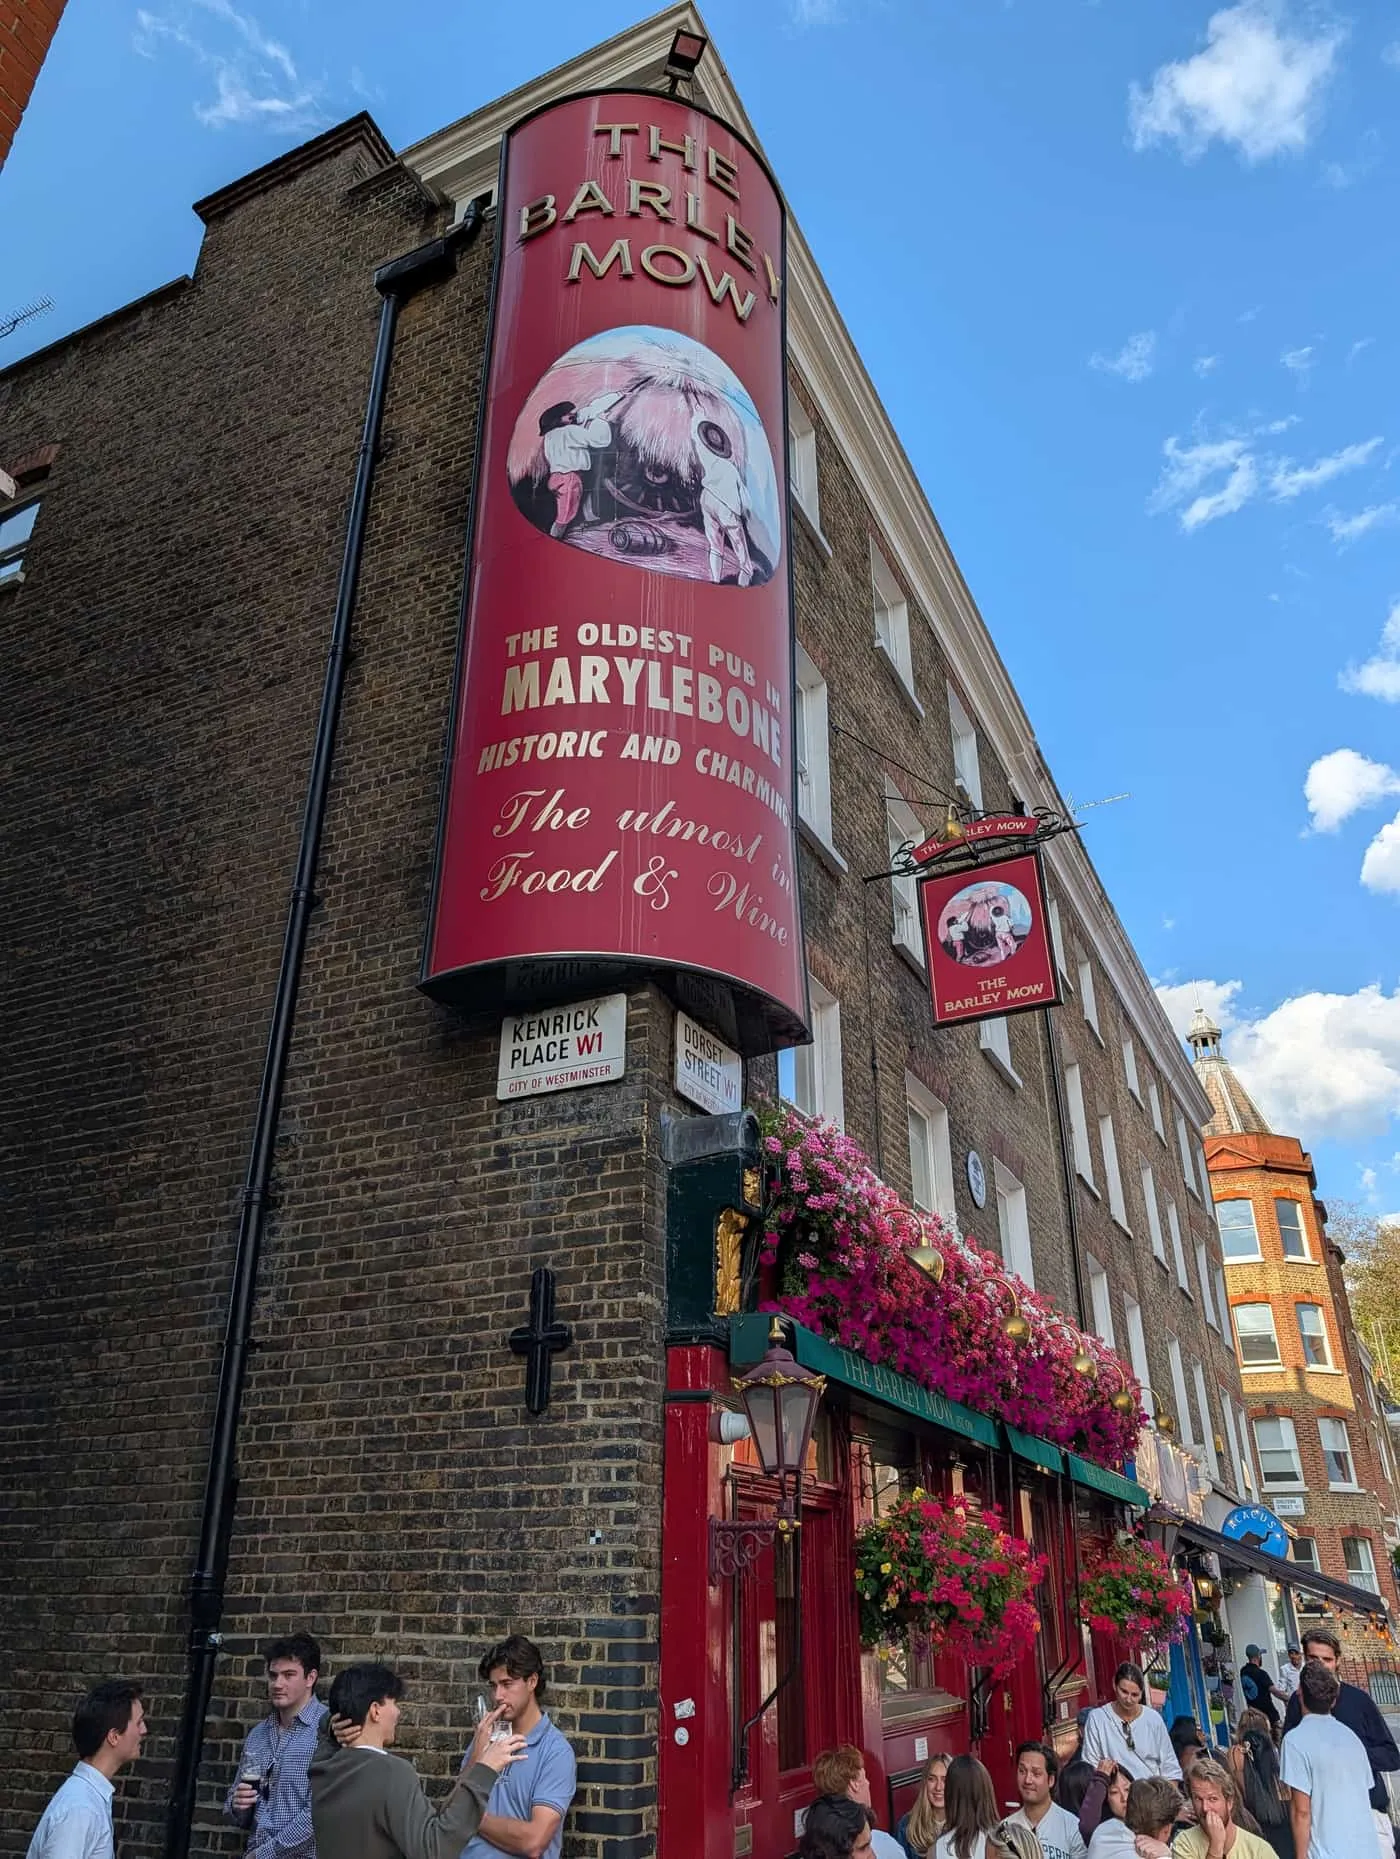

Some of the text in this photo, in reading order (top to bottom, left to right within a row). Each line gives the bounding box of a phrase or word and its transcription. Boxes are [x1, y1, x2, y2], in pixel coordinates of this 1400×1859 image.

[593, 123, 740, 200] THE
[517, 178, 781, 302] BARLEY
[565, 239, 757, 321] MOW
[505, 622, 781, 713] THE OLDEST PUB IN
[500, 655, 782, 768] MARYLEBONE
[477, 730, 790, 829] HISTORIC AND CHARMING
[492, 788, 792, 897] The utmost in
[996, 821, 1028, 831] MOW
[480, 850, 788, 947] Food & Wine
[944, 983, 1045, 1013] BARLEY MOW
[977, 976, 1008, 992] THE
[510, 1031, 604, 1070] PLACE W1
[512, 1006, 600, 1044] KENRICK
[684, 1023, 724, 1066] DORSET
[508, 1064, 612, 1094] CITY OF WESTMINSTER
[684, 1048, 722, 1091] STREET
[724, 1079, 738, 1101] W1
[843, 1350, 872, 1388] THE
[873, 1365, 921, 1411] BARLEY
[924, 1390, 954, 1426] MOW
